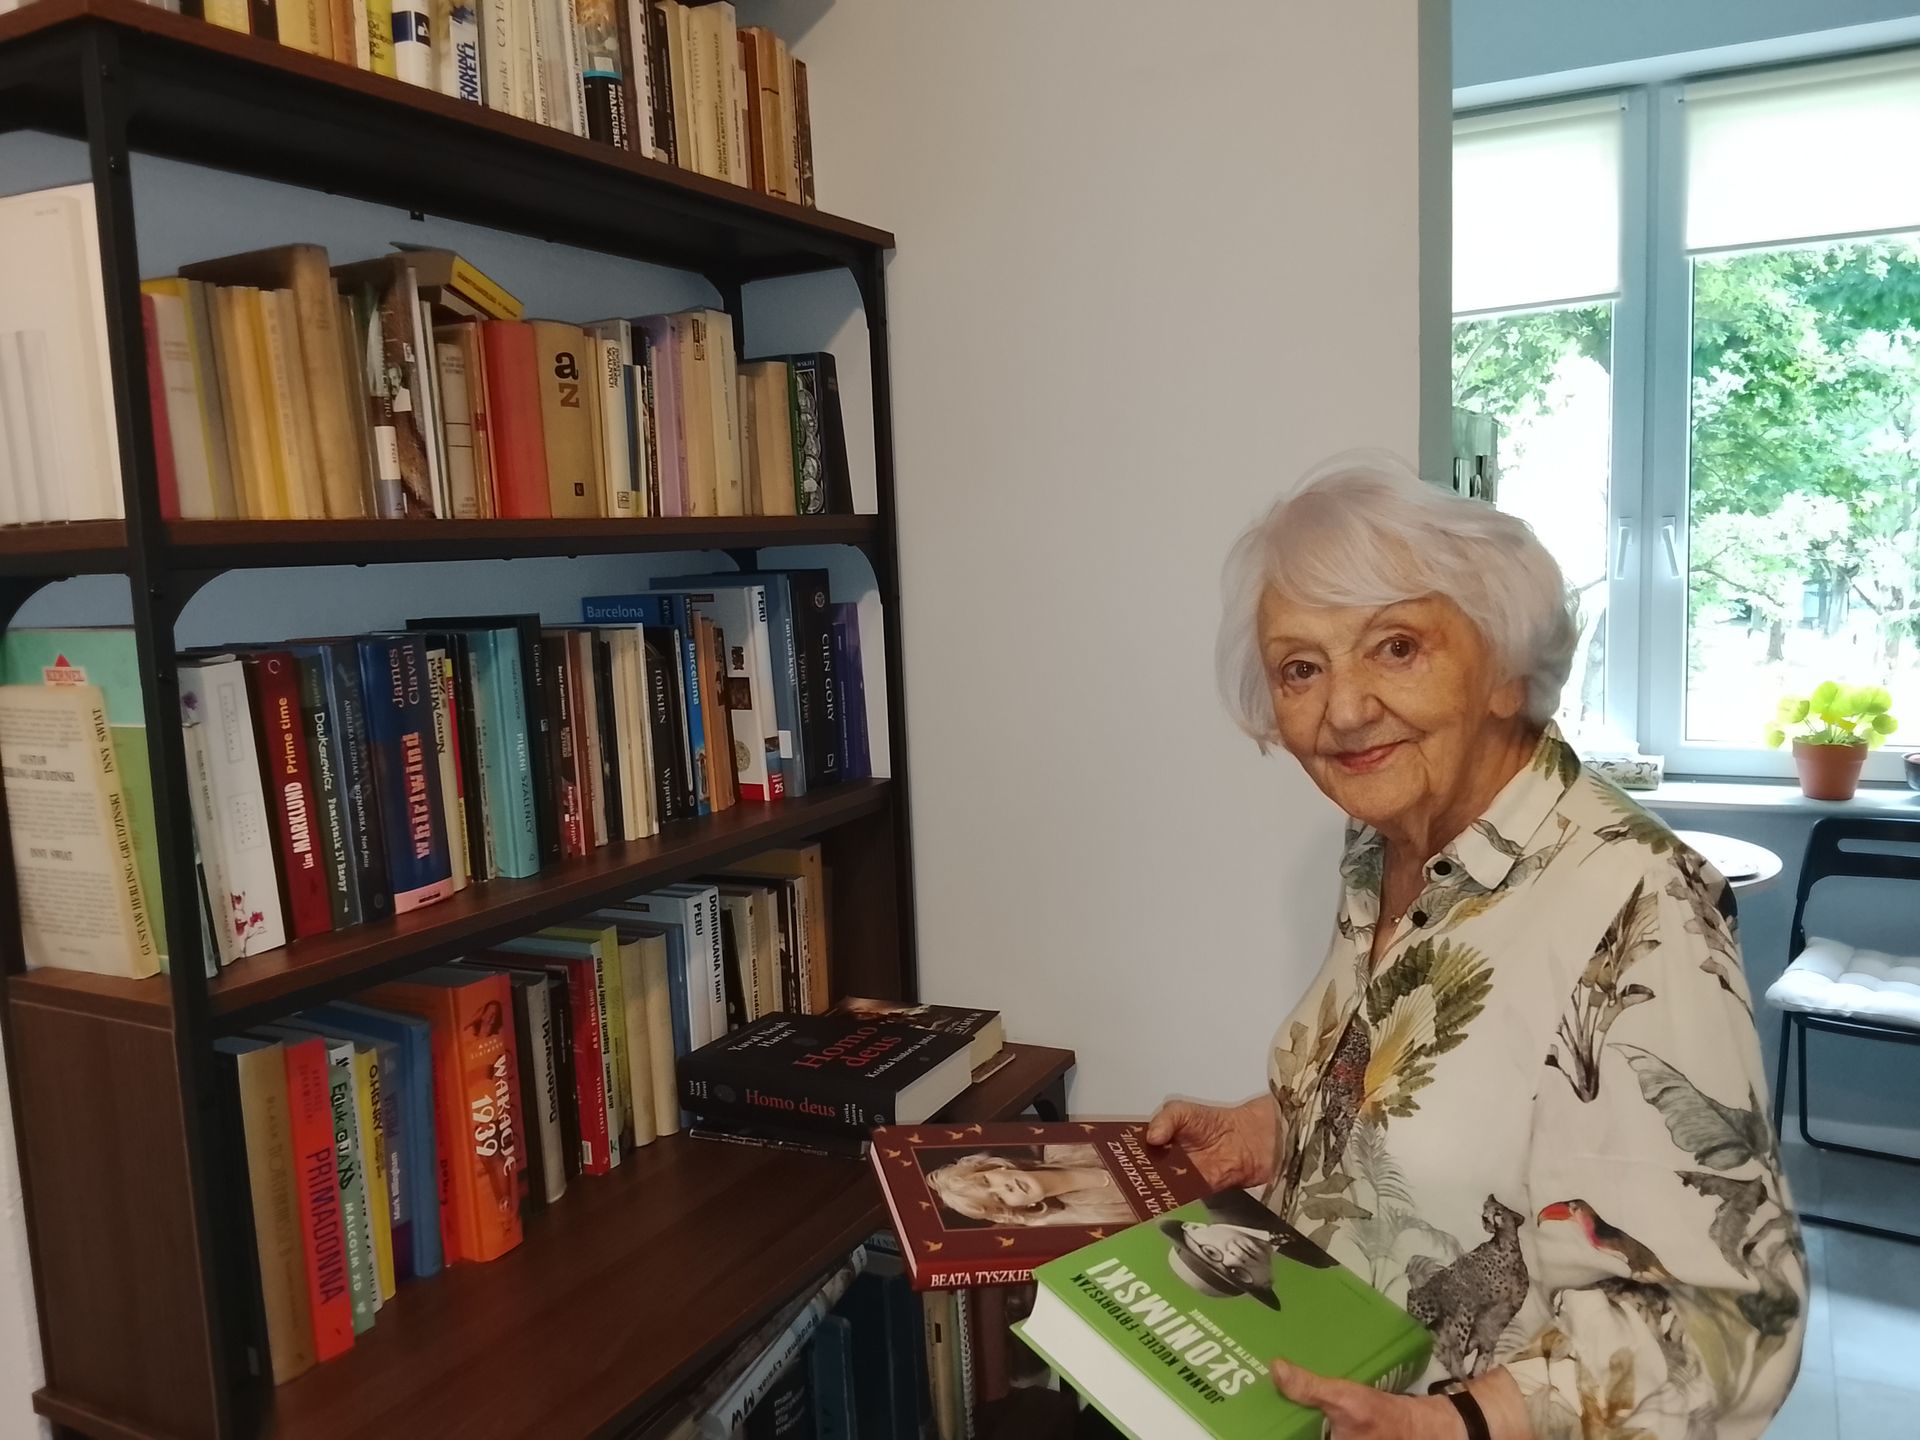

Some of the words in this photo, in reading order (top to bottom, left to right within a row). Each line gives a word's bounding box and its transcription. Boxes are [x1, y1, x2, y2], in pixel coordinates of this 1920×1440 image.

[456, 42, 470, 101] ENNING
[555, 351, 578, 381] a
[586, 604, 644, 618] Barcelona
[757, 591, 767, 622] PERU
[388, 648, 405, 708] James
[402, 644, 420, 705] Clavell
[427, 658, 441, 711] Milford
[688, 643, 700, 705] Barcelona
[278, 697, 291, 730] time
[433, 711, 446, 754] Nancy
[100, 747, 114, 774] INNY
[285, 732, 298, 774] Prime
[774, 782, 784, 795] 25
[284, 781, 312, 854] MARKLUND
[134, 912, 151, 957] GUSTAW
[693, 902, 702, 936] PERU
[709, 894, 720, 972] DOMINIKANA
[728, 1030, 763, 1052] Yuval
[761, 1020, 792, 1036] Noah
[759, 1028, 797, 1048] Harari
[793, 1026, 879, 1070] Homo
[840, 1035, 903, 1068] deus
[493, 1055, 517, 1177] WAKACJE
[745, 1088, 795, 1110] Homo
[799, 1097, 836, 1118] deus
[471, 1095, 498, 1157] 1939
[1106, 1141, 1152, 1197] TYSZKIEWICZ
[1144, 1171, 1168, 1189] LUBI
[306, 1147, 345, 1305] PRIMADONNA
[1144, 1197, 1163, 1217] ATA
[345, 1202, 359, 1268] MALCOLM
[353, 1274, 362, 1291] XD
[930, 1271, 972, 1288] BEATA
[1086, 1257, 1257, 1398] SŁONIMSKI
[1174, 1364, 1225, 1407] JOANNA
